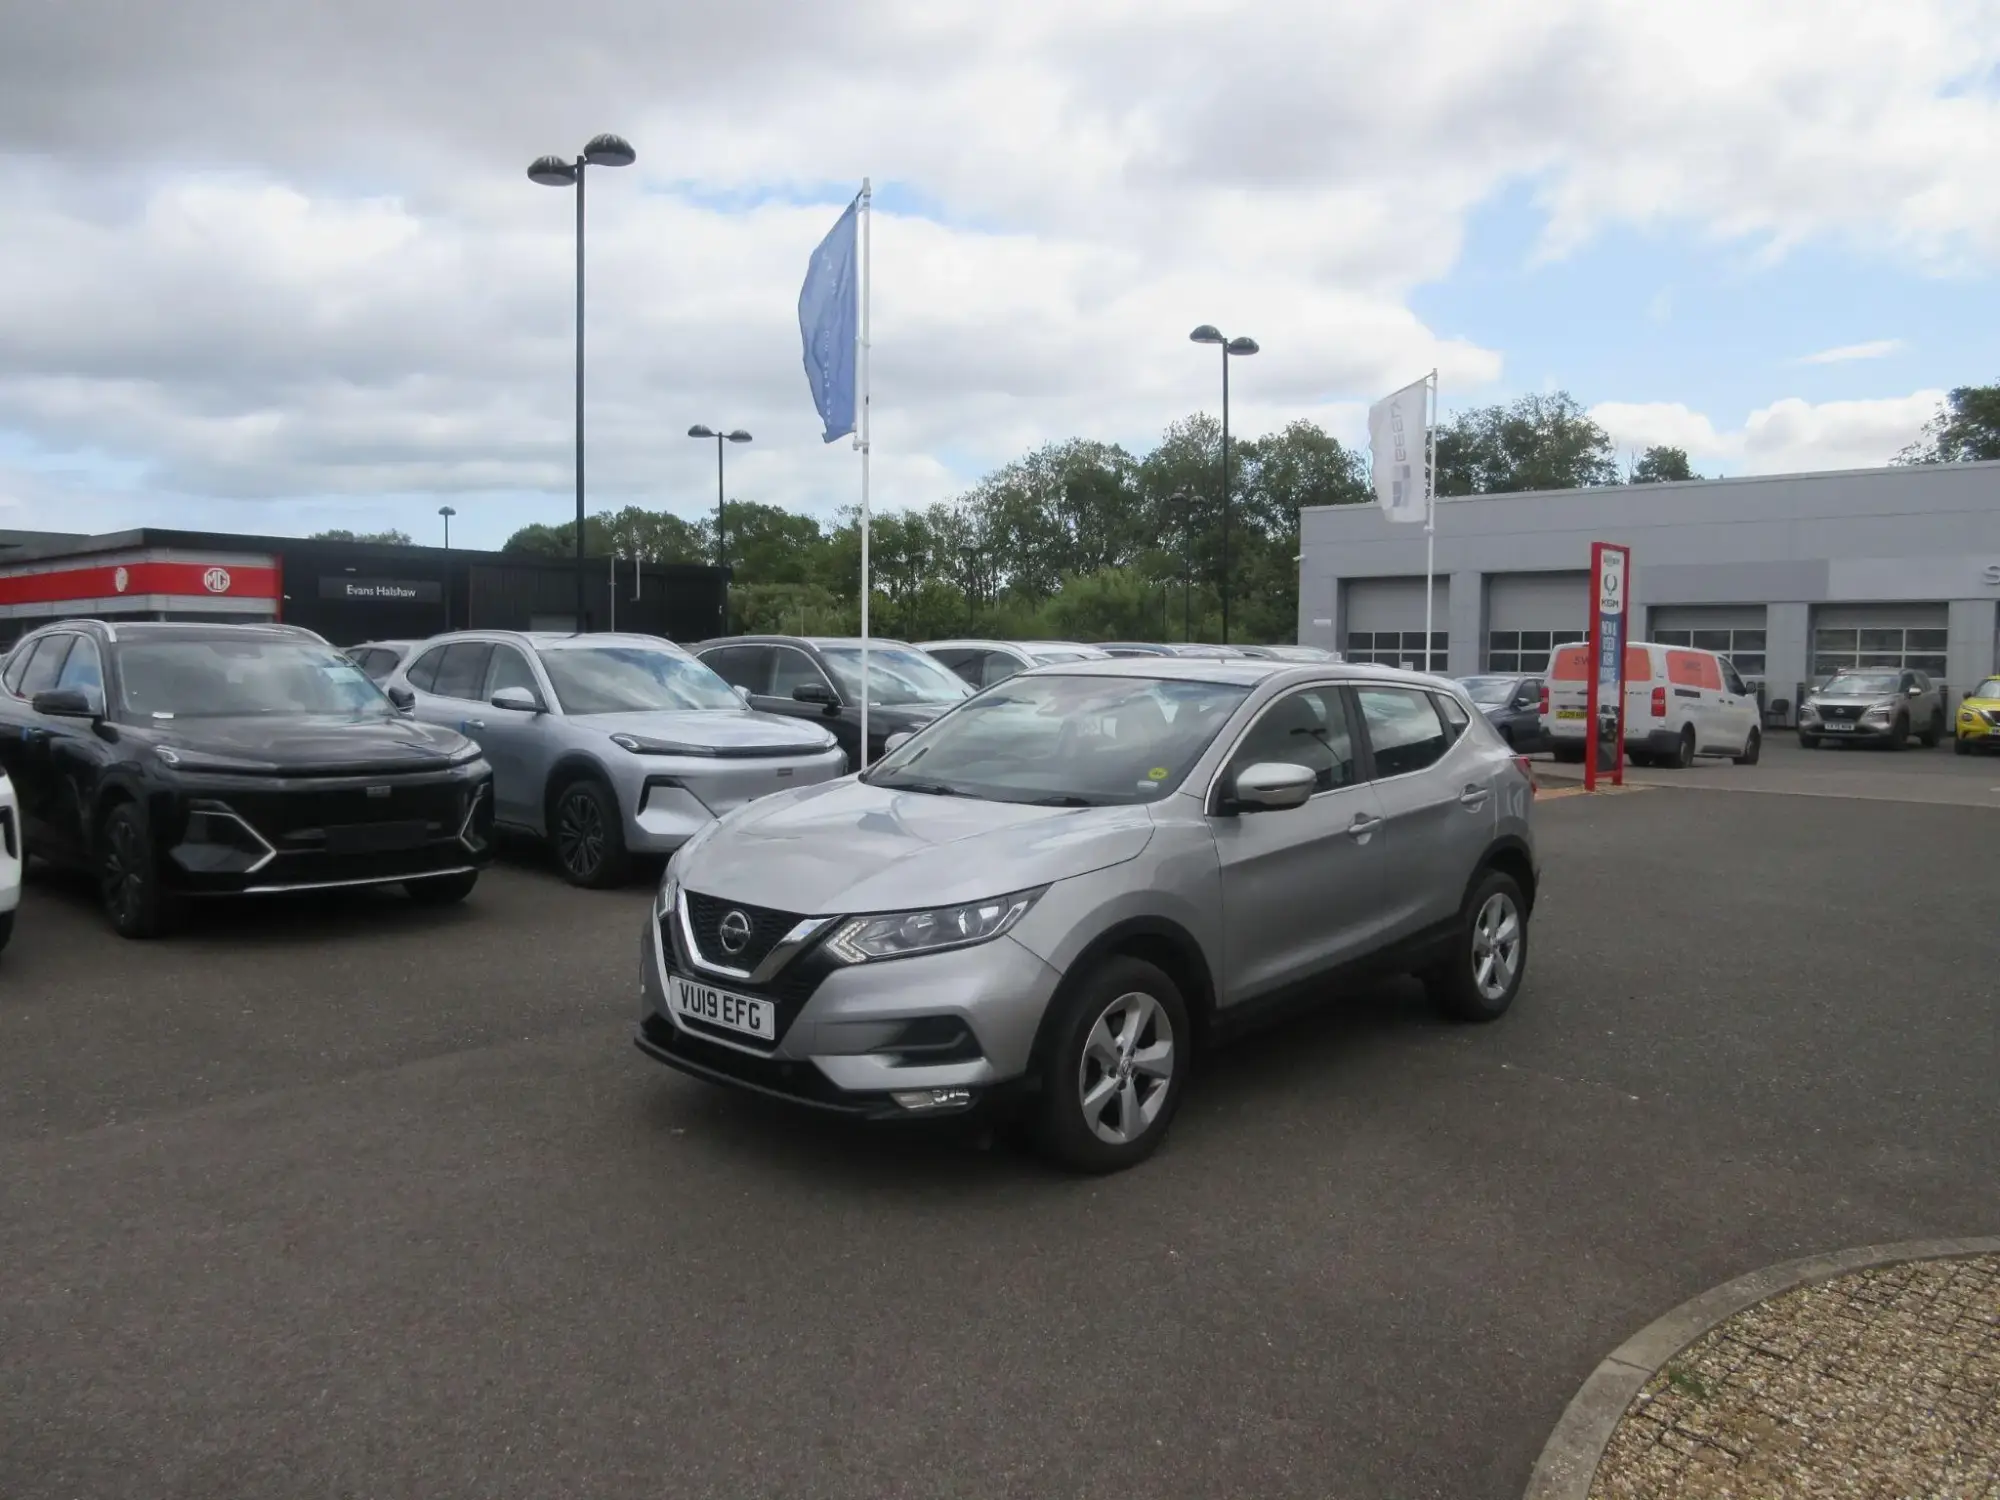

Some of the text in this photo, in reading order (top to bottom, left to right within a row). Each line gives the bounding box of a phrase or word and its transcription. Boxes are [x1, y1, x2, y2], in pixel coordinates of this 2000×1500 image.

[206, 570, 228, 590] MG
[346, 584, 416, 597] Evans Halshaw
[680, 983, 760, 1030] VU19 EFG
